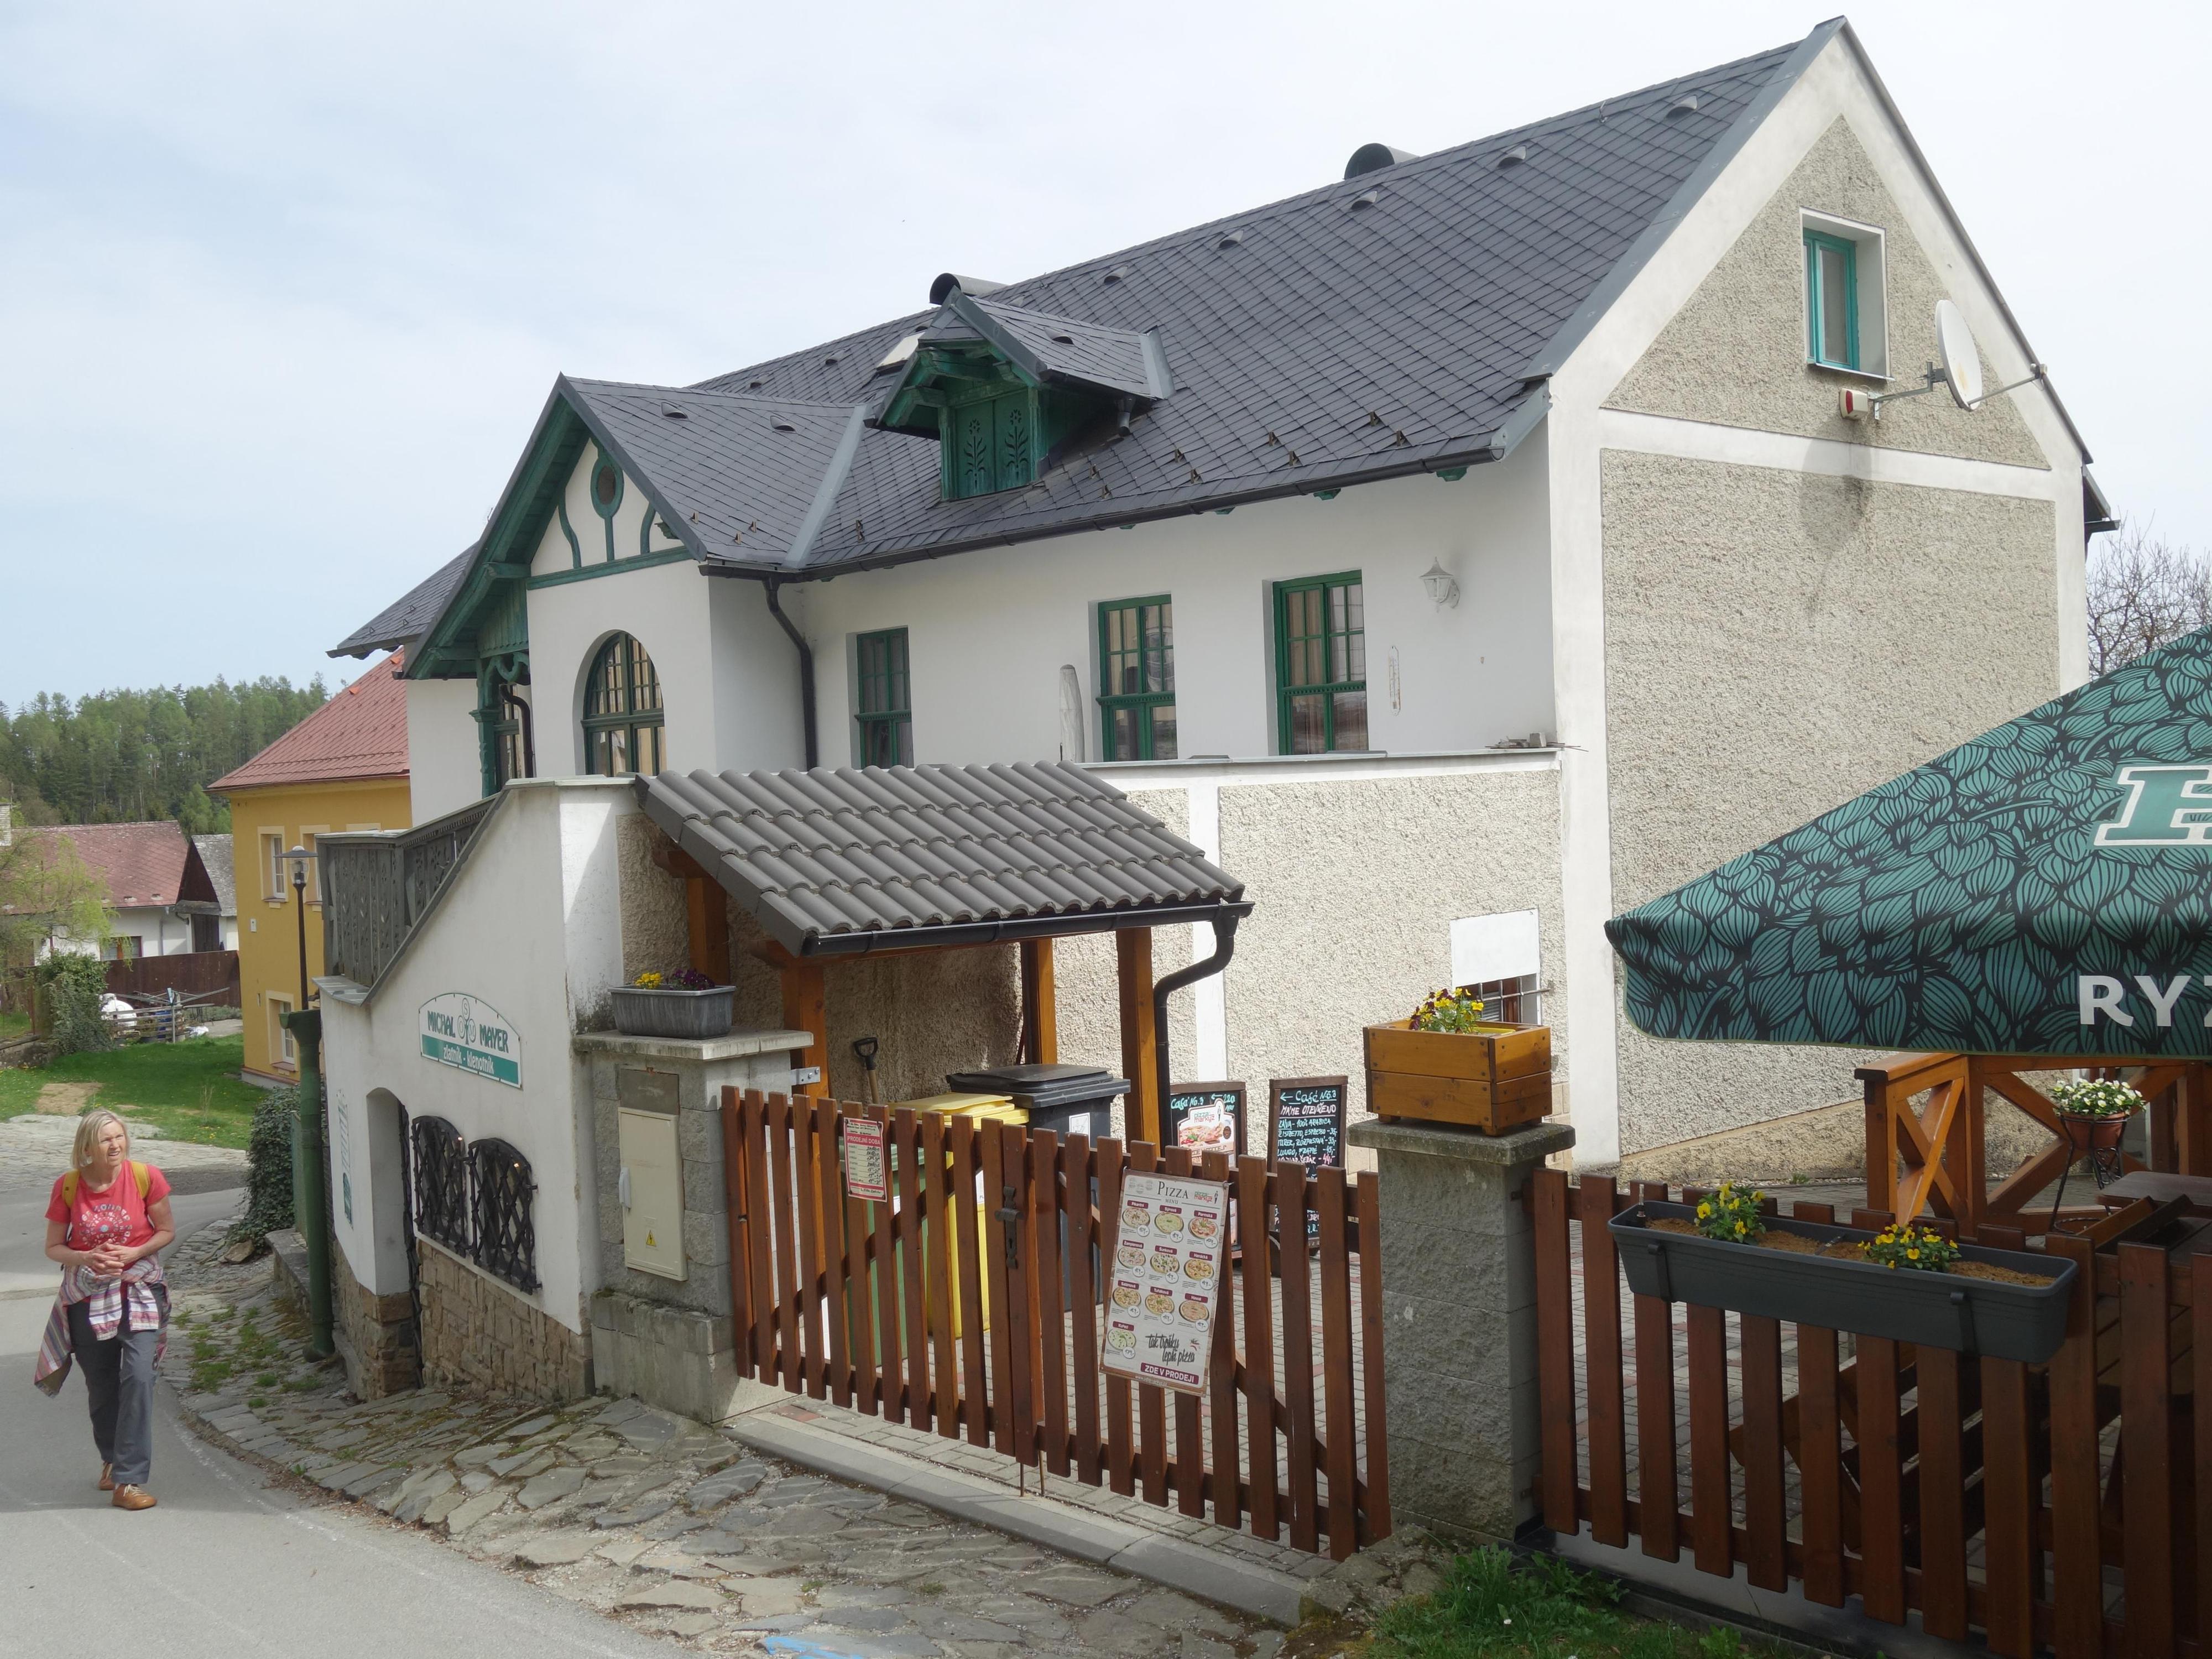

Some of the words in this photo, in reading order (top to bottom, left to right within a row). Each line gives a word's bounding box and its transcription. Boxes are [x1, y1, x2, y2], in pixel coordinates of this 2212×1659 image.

[2079, 975, 2212, 1027] RY
[427, 1010, 456, 1038] MICHAL
[479, 1024, 509, 1053] MAYER
[444, 1044, 462, 1064] zlatník
[467, 1050, 494, 1074] klenotník
[1145, 1365, 1159, 1375] ZDE
[1165, 1370, 1194, 1383] PRODEJI
